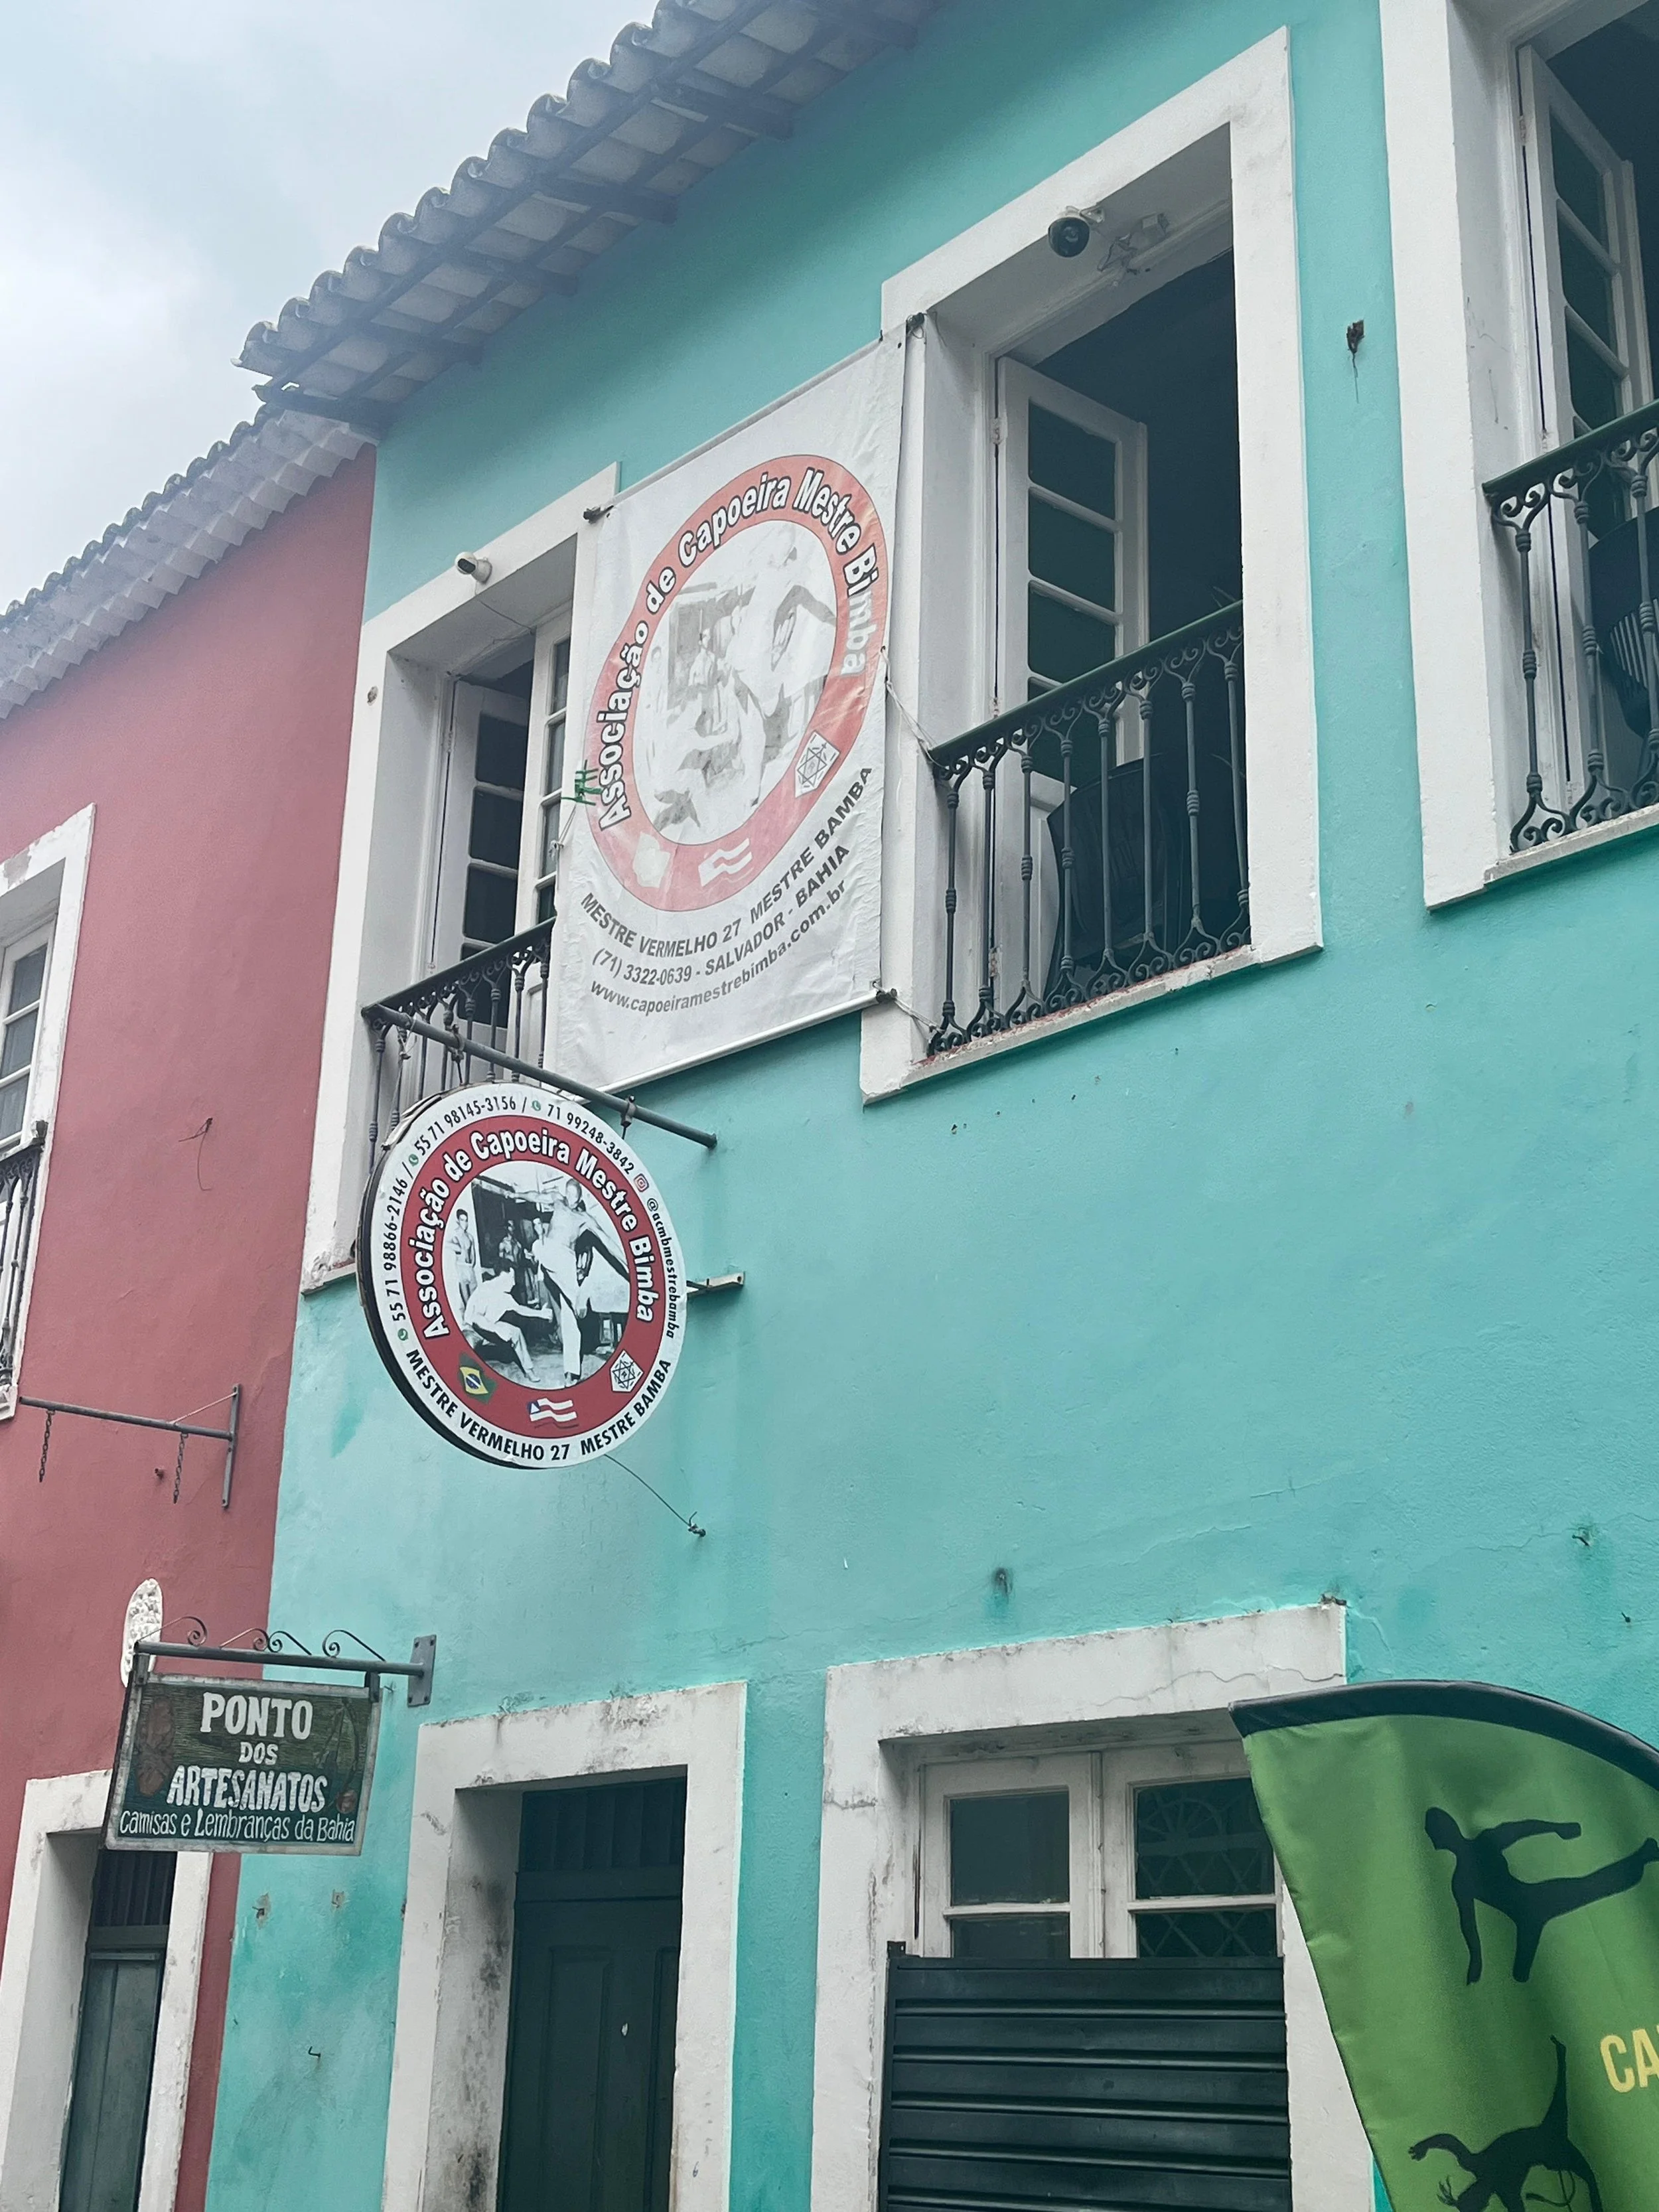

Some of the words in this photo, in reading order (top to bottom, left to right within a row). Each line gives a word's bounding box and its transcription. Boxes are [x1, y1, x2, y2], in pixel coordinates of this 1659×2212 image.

[596, 620, 649, 832] Associação
[646, 566, 677, 615] de
[678, 471, 792, 568] Capoeira
[792, 467, 861, 555] Mestre
[841, 542, 879, 676] Bimba
[581, 892, 637, 948] MESTRE
[639, 931, 718, 958] VERMELHO
[722, 918, 742, 943] 27
[750, 846, 815, 924] MESTRE
[814, 768, 873, 849] BAMBA
[592, 948, 622, 978] (71)
[623, 964, 691, 986] 3322-0639
[705, 912, 786, 976] SALVADOR
[795, 845, 850, 908] BAHIA
[591, 879, 846, 1017] www.capoeiramestrebimba.com.br
[427, 1121, 445, 1140] 71
[443, 1096, 516, 1128] 98145-3156
[547, 1104, 561, 1120] 71
[414, 1135, 431, 1155] 55
[567, 1112, 635, 1175] 99248-3842
[383, 1177, 408, 1271] 98866-2146
[408, 1177, 451, 1339] Associação
[442, 1149, 472, 1182] de
[469, 1127, 571, 1165] Capoeira
[574, 1146, 638, 1232] Mestre
[629, 1235, 659, 1323] Bimba
[386, 1279, 400, 1297] 71
[646, 1197, 681, 1339] @acmbmestrebamba
[390, 1302, 406, 1321] 55
[406, 1349, 458, 1418] MESTRE
[459, 1412, 544, 1461] VERMELHO
[550, 1443, 571, 1461] 27
[580, 1412, 636, 1455] MESTRE
[633, 1360, 672, 1418] BAMBA
[200, 1692, 313, 1740] PONTO
[238, 1741, 279, 1765] DOS
[166, 1765, 328, 1813] ARTESANATOS
[119, 1810, 177, 1835] Camisas
[180, 1816, 190, 1836] e
[194, 1808, 289, 1843] Lembranças
[295, 1814, 313, 1842] da
[317, 1813, 355, 1842] Bahia
[1600, 2024, 1659, 2093] CA
